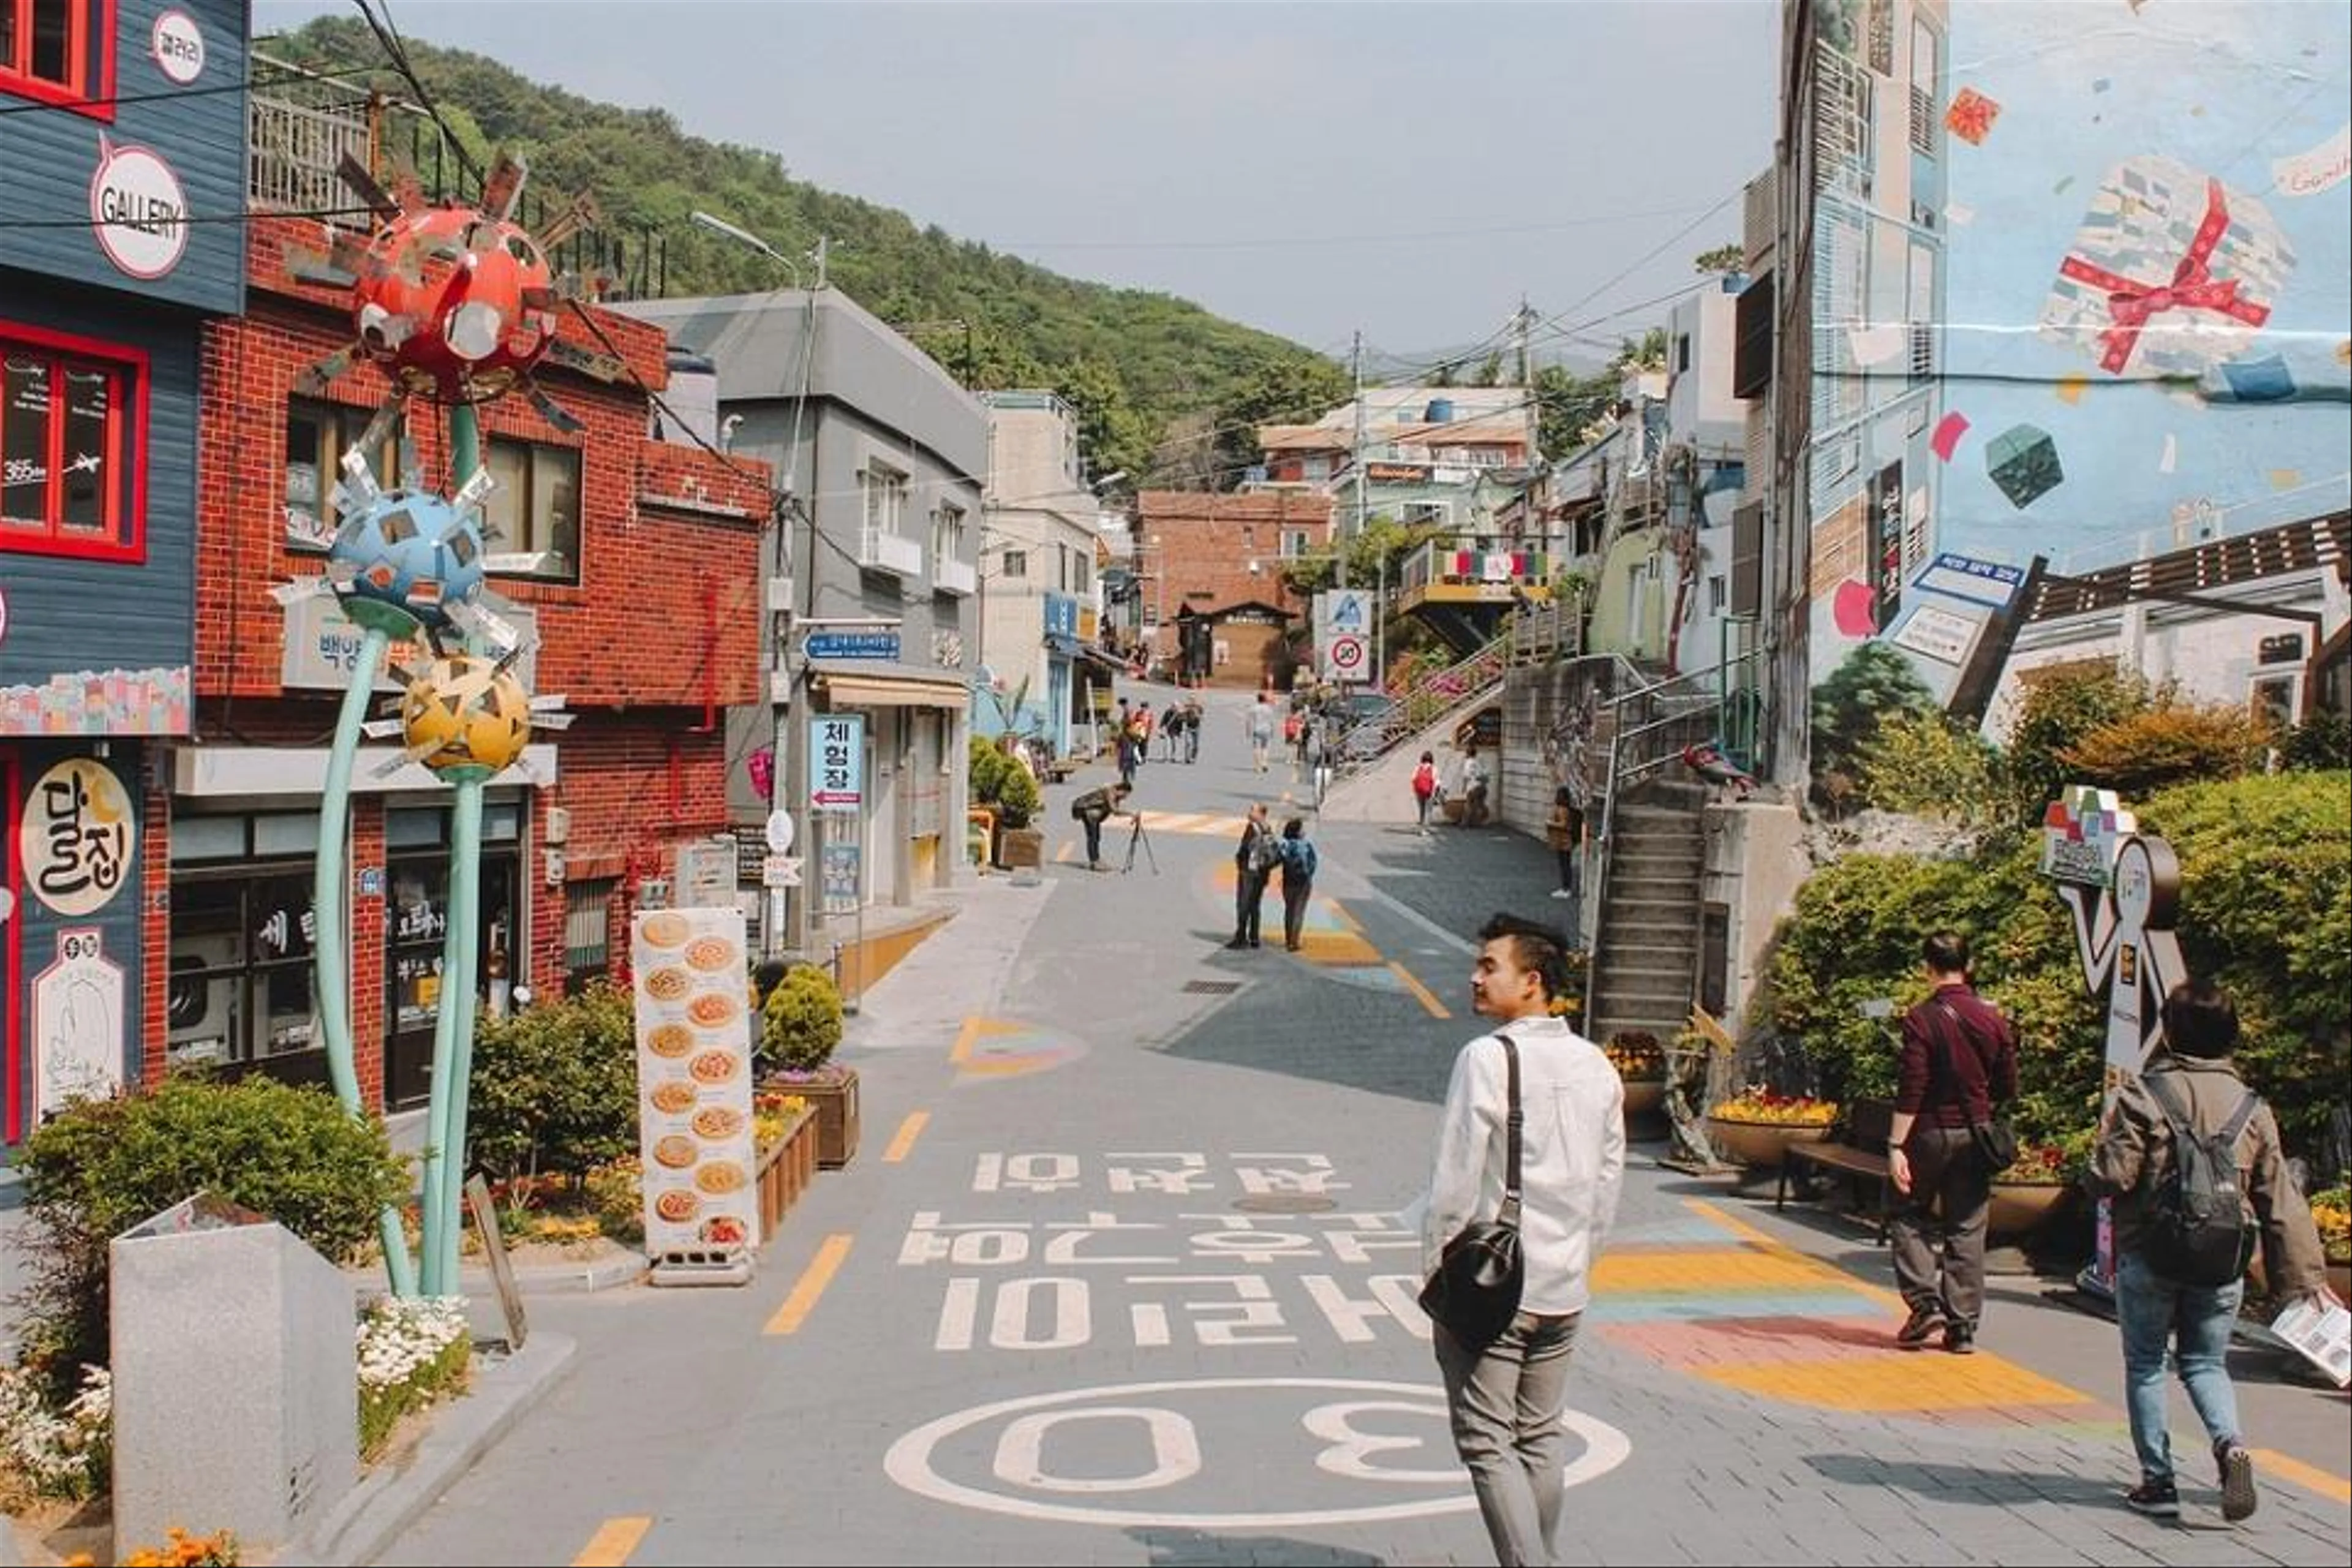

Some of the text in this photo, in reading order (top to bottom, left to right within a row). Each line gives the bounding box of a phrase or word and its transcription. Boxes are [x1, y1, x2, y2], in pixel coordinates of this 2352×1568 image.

[101, 187, 183, 240] GALLERY
[973, 1152, 1352, 1193] 천천히
[934, 1275, 1433, 1350] 어린이
[992, 1401, 1471, 1491] 30
